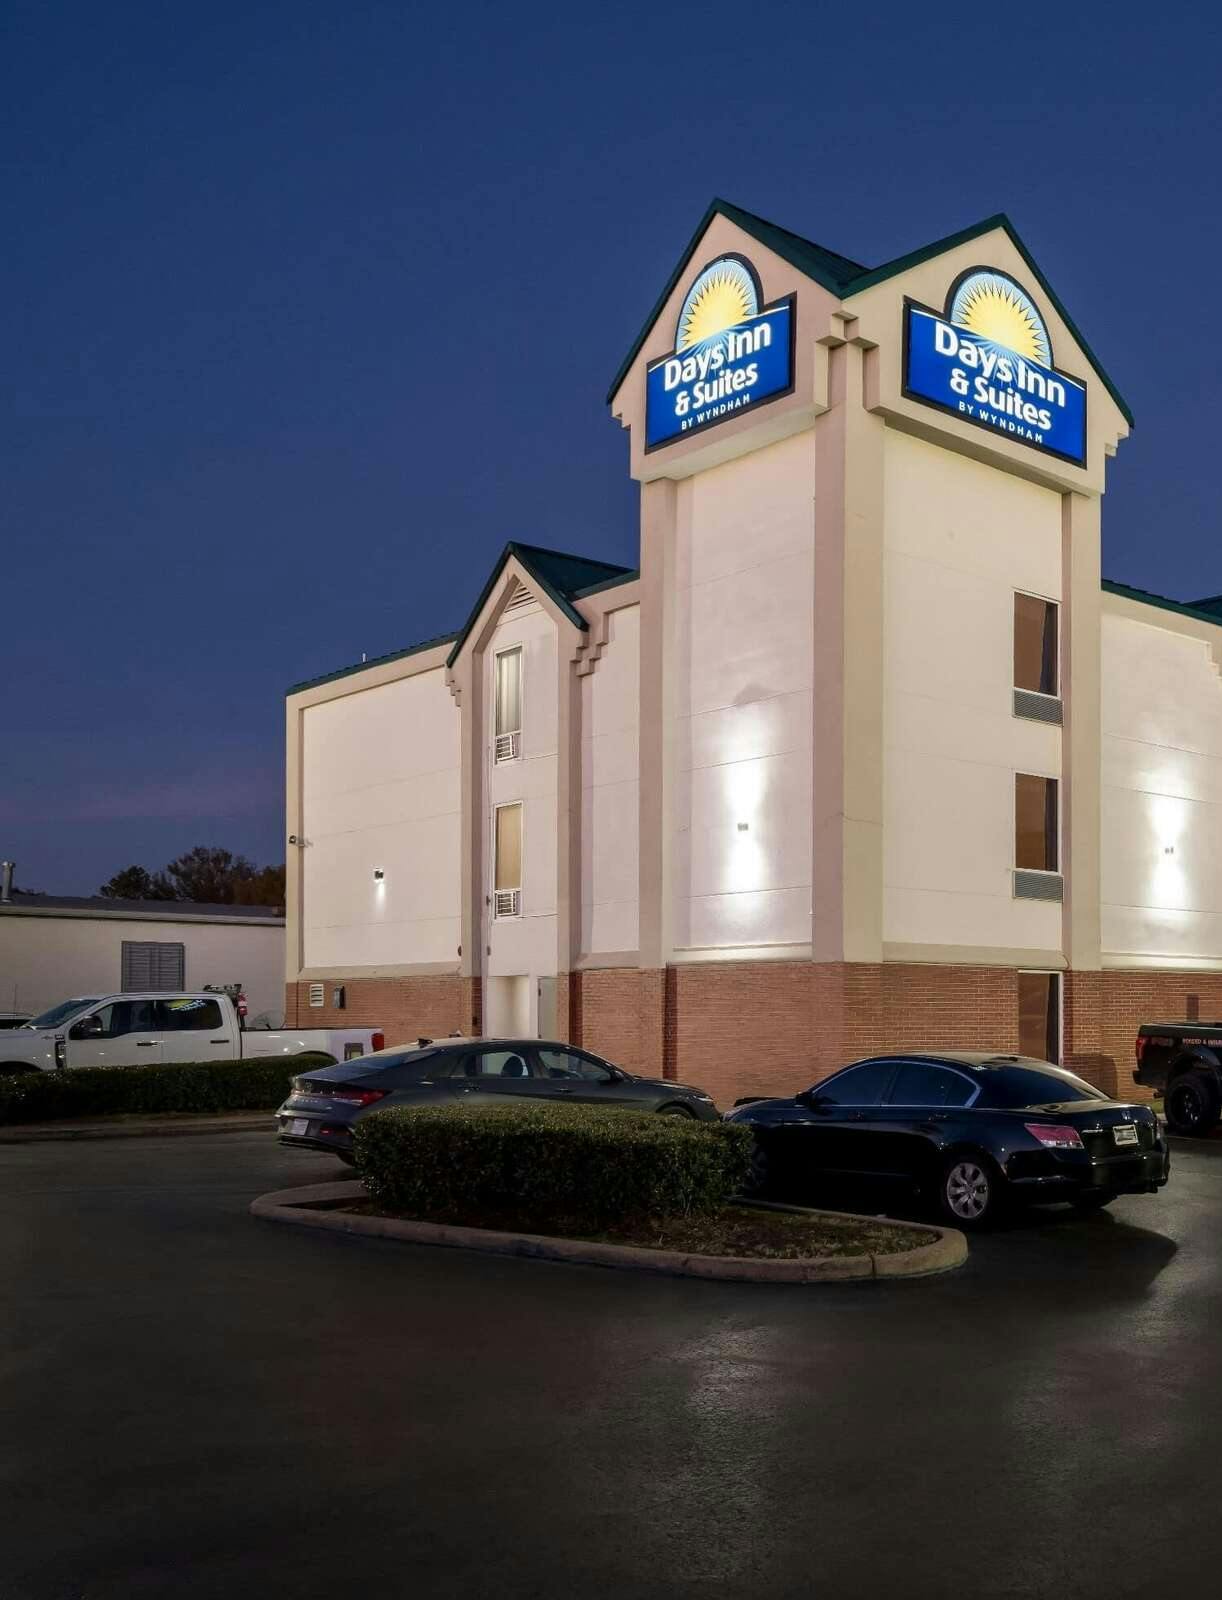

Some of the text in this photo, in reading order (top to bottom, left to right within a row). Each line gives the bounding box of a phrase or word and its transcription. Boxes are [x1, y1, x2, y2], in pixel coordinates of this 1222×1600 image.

[664, 322, 771, 392] Days Inn
[935, 321, 1065, 407] Days Inn
[675, 363, 758, 416] & Suites
[681, 393, 751, 430] BY WYNDHAM
[950, 368, 1052, 430] & Suites
[958, 400, 1043, 444] BY WYNDHAM
